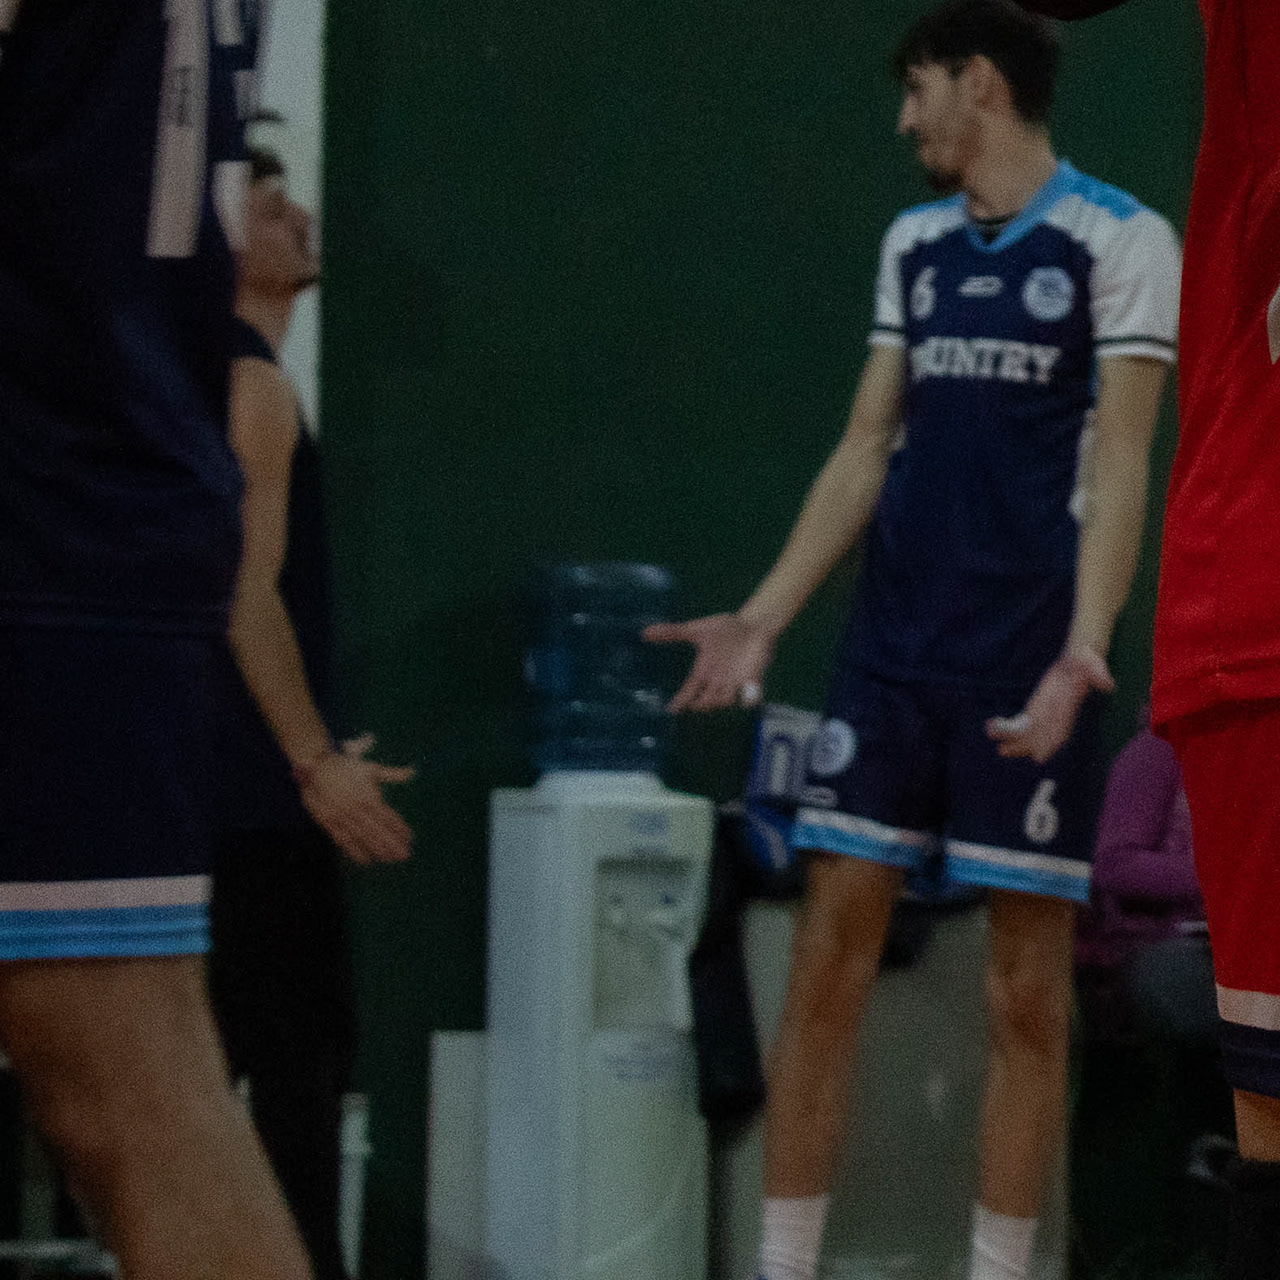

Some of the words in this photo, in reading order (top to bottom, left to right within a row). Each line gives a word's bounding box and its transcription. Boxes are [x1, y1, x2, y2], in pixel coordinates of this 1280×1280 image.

[911, 266, 938, 320] 6
[912, 335, 1062, 385] UNTRY
[1024, 779, 1060, 843] 6
